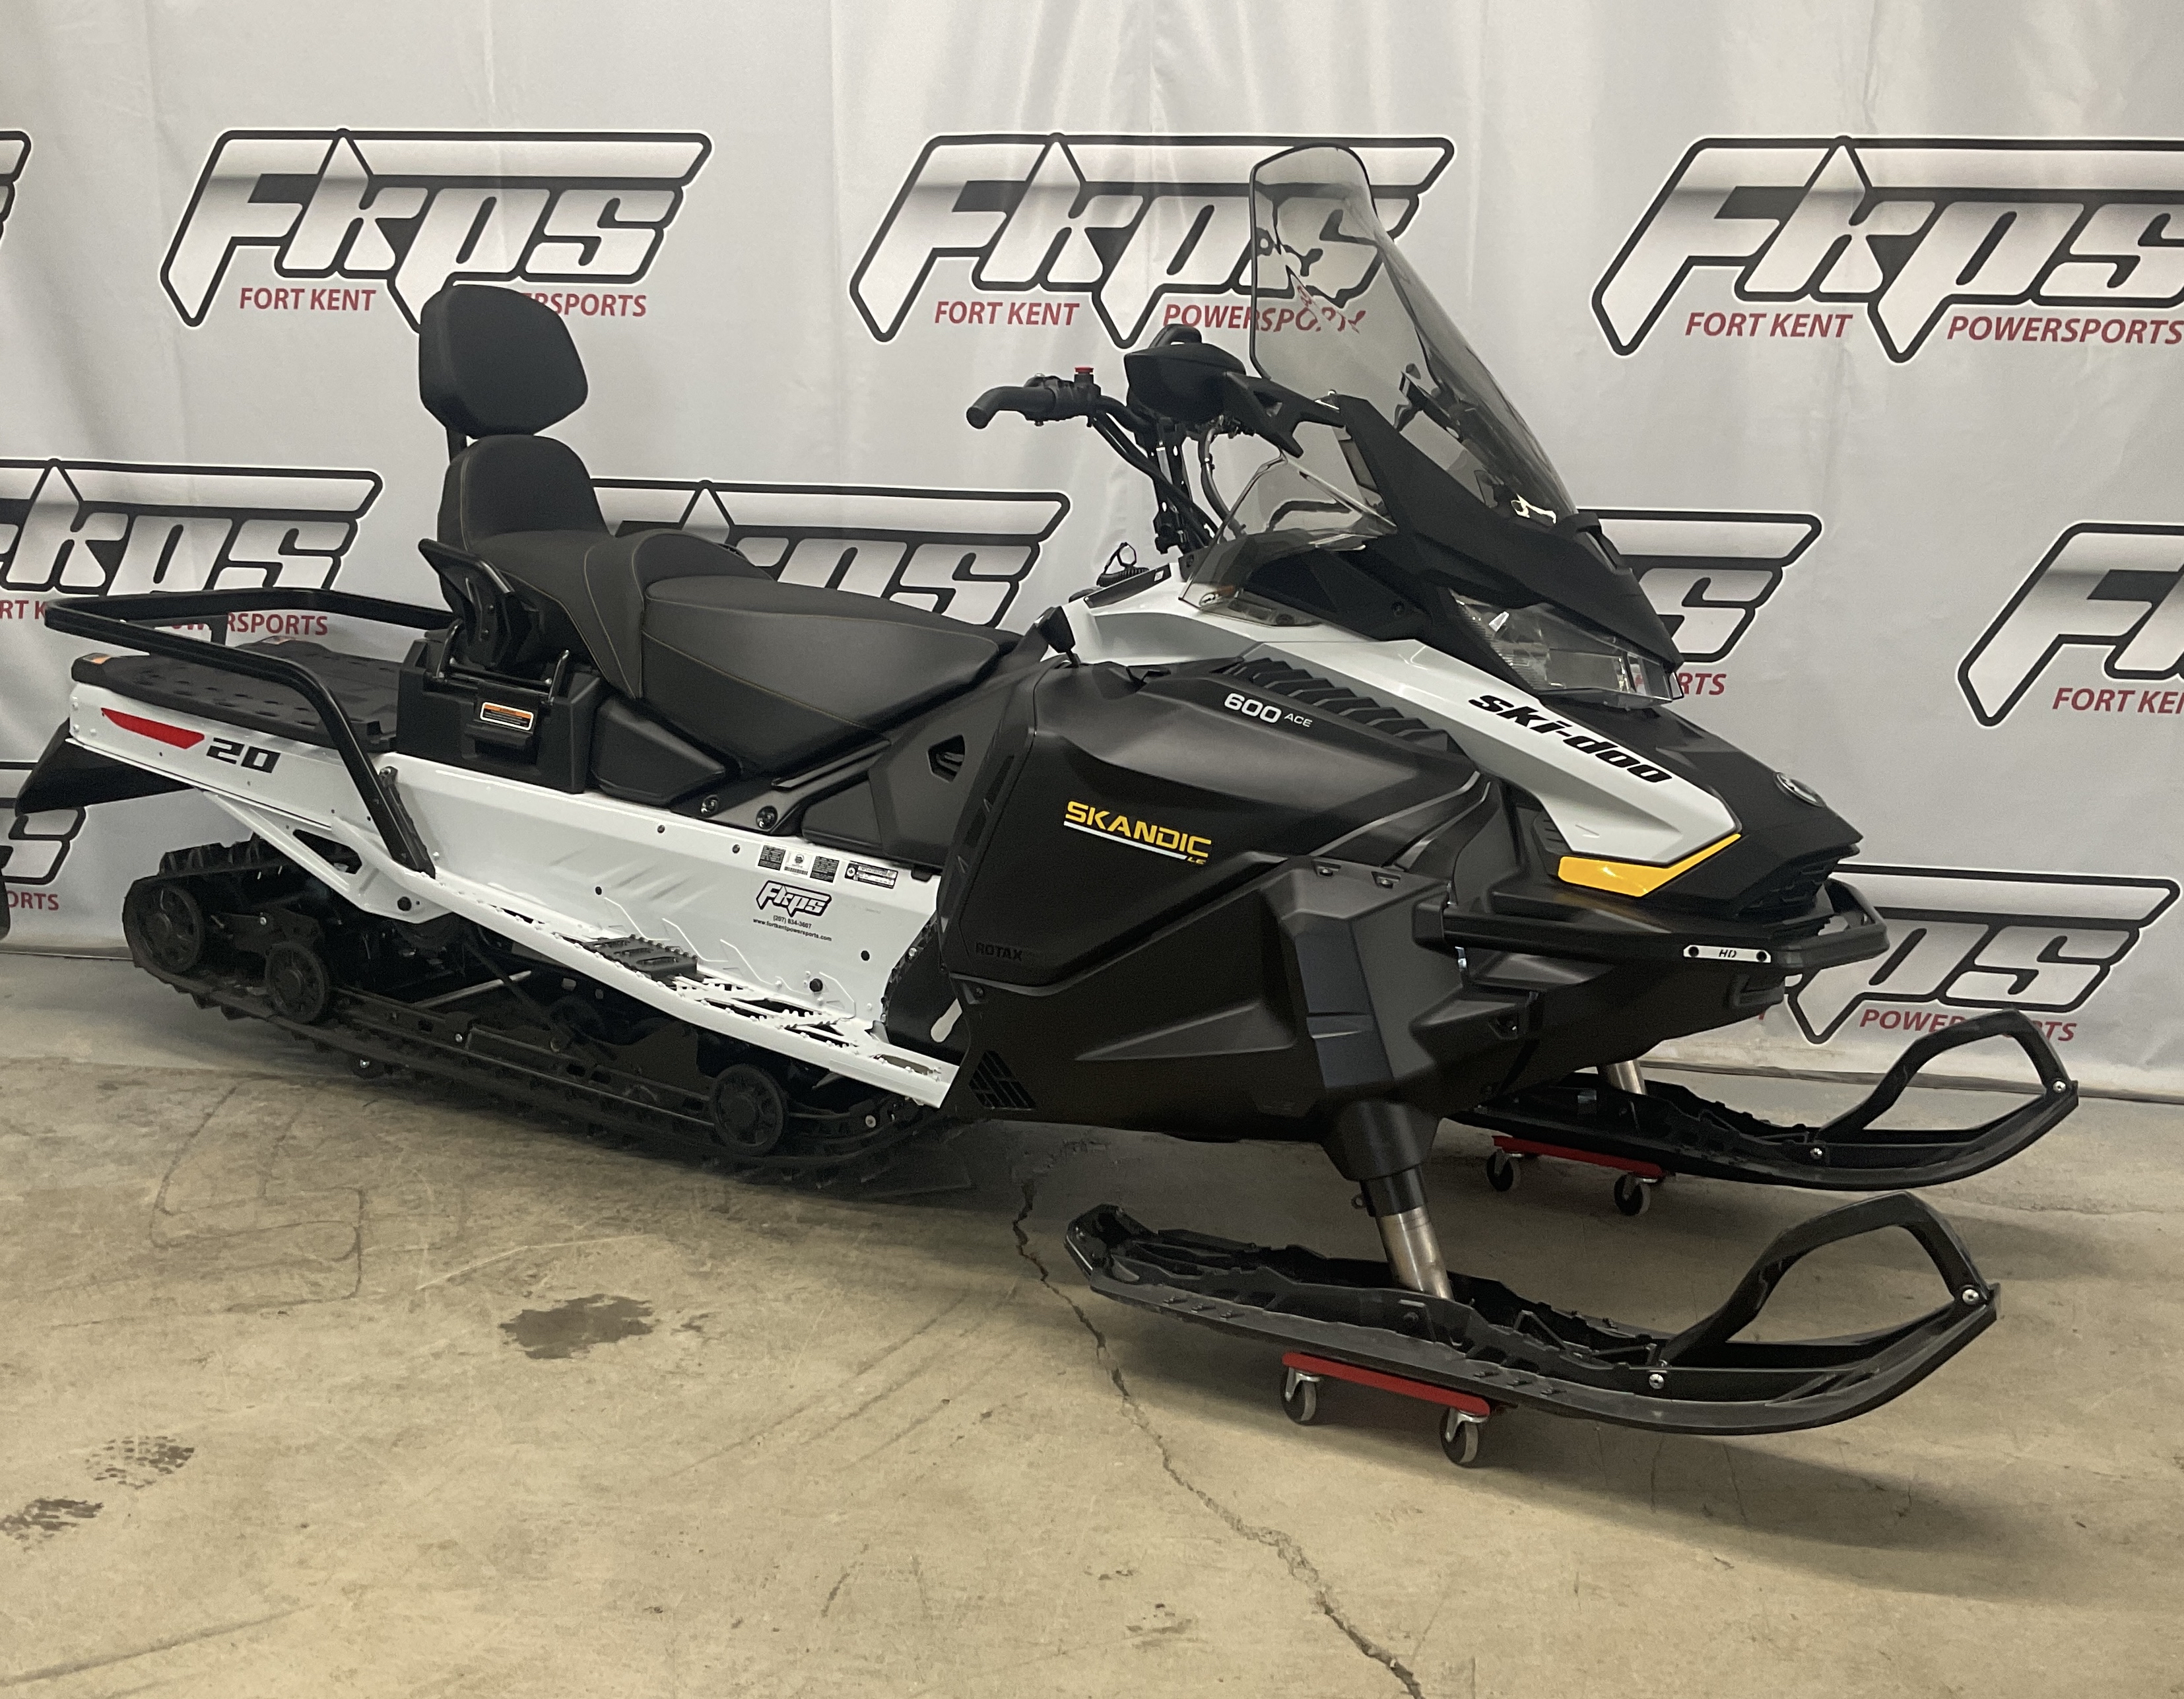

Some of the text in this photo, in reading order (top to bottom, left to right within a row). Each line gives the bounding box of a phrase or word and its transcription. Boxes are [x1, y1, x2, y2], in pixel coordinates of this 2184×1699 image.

[239, 288, 376, 312] FORT KENT
[934, 301, 1080, 326] FORT KENT
[1685, 312, 1852, 339] FORT KENT
[1947, 316, 2184, 345] POWERSPORTS
[1224, 693, 1313, 727] 600 ACE
[2052, 688, 2184, 714] FORT KE
[206, 737, 281, 774] 20
[1064, 800, 1212, 858] SKANDIC
[976, 942, 1022, 962] ROTAX
[1718, 949, 1737, 958] HD
